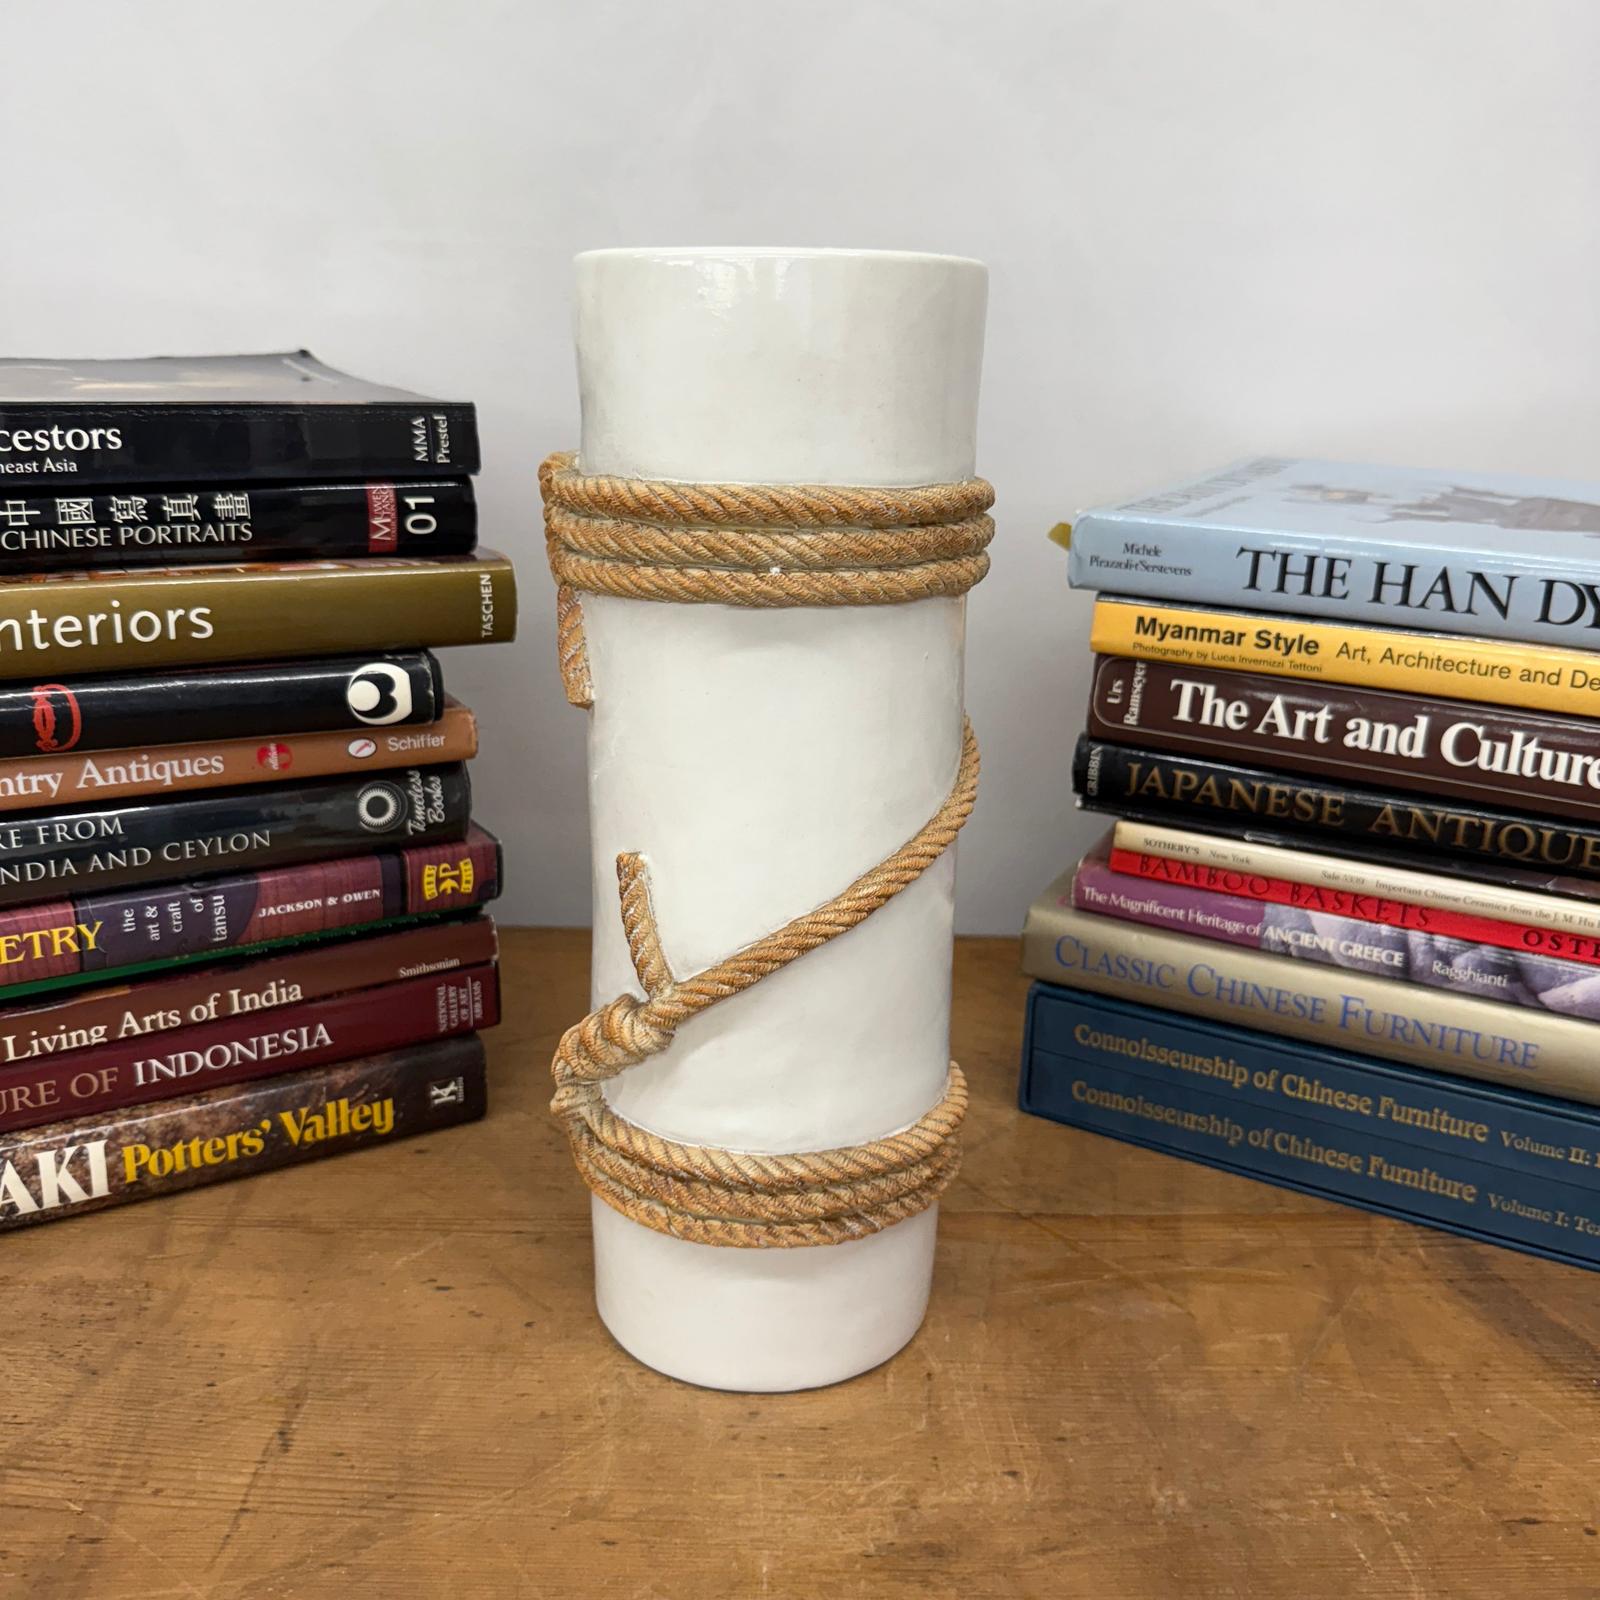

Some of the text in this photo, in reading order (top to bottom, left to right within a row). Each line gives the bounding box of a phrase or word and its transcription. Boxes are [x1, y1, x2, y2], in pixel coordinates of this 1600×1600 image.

[411, 416, 429, 462] MMA
[433, 415, 450, 463] Prestel
[43, 457, 78, 472] Asia
[1, 522, 253, 550] CHINESE PORTRAITS
[404, 496, 438, 534] 01
[481, 573, 494, 638] TASCHEN
[1236, 546, 1352, 600] THE
[1368, 561, 1520, 620] HAN
[0, 600, 214, 650] nteriors
[1132, 642, 1322, 673] Photography by Luca Invernizzi Tettoni
[1135, 616, 1600, 691] Myanmar Style Art, Architecture and De
[1107, 679, 1124, 705] Urs
[1124, 661, 1148, 726] Ramseyer
[388, 734, 446, 752] Schiffer
[1170, 679, 1600, 790] The Art and Culture
[76, 754, 225, 788] Antiques
[406, 770, 426, 835] Timeless
[424, 776, 445, 822] Books
[1125, 763, 1600, 870] JAPANESE ANTIQUE
[37, 817, 124, 845] FROM
[89, 847, 151, 873] AND
[163, 830, 271, 861] CEYLON
[190, 897, 204, 912] of
[258, 889, 381, 918] JACKSON & OWEN
[1139, 854, 1271, 895] BAMBOO
[1289, 882, 1433, 928] BASKETS
[1143, 838, 1200, 855] SOTHEBY'S
[1210, 850, 1228, 860] New
[1231, 854, 1250, 864] York
[1321, 870, 1340, 880] Sale
[1375, 880, 1421, 897] Important
[1424, 888, 1461, 903] Chinese
[1463, 895, 1507, 911] Ceramics
[1509, 904, 1532, 916] from
[1535, 909, 1550, 920] the
[1578, 916, 1594, 928] Hu
[123, 908, 136, 933] the
[145, 906, 160, 941] art &
[168, 901, 183, 933] craft
[212, 895, 227, 942] tansu
[1083, 887, 1508, 988] The Magnificent Heritage of ANCIENT GREECE Ragghianti
[0, 921, 103, 965] ETRY
[2, 957, 460, 1062] Living Arts of India Smithsonian
[1055, 935, 1540, 1071] CLASSIC CHINESE FURNITURE
[70, 1067, 119, 1099] OF
[133, 1022, 335, 1087] INDONESIA
[1074, 1023, 1249, 1089] Connoisseurship
[1253, 1069, 1279, 1091] of
[1281, 1073, 1372, 1115] Chinese
[1378, 1096, 1490, 1143] Furniture
[1501, 1130, 1565, 1159] Volume
[0, 1097, 394, 1219] AKI Potters' Valley
[1071, 1080, 1243, 1146] Connoisseurship
[1248, 1128, 1273, 1148] of
[1274, 1132, 1362, 1174] Chinese
[1367, 1153, 1477, 1203] Furniture
[1488, 1192, 1552, 1223] Volume
